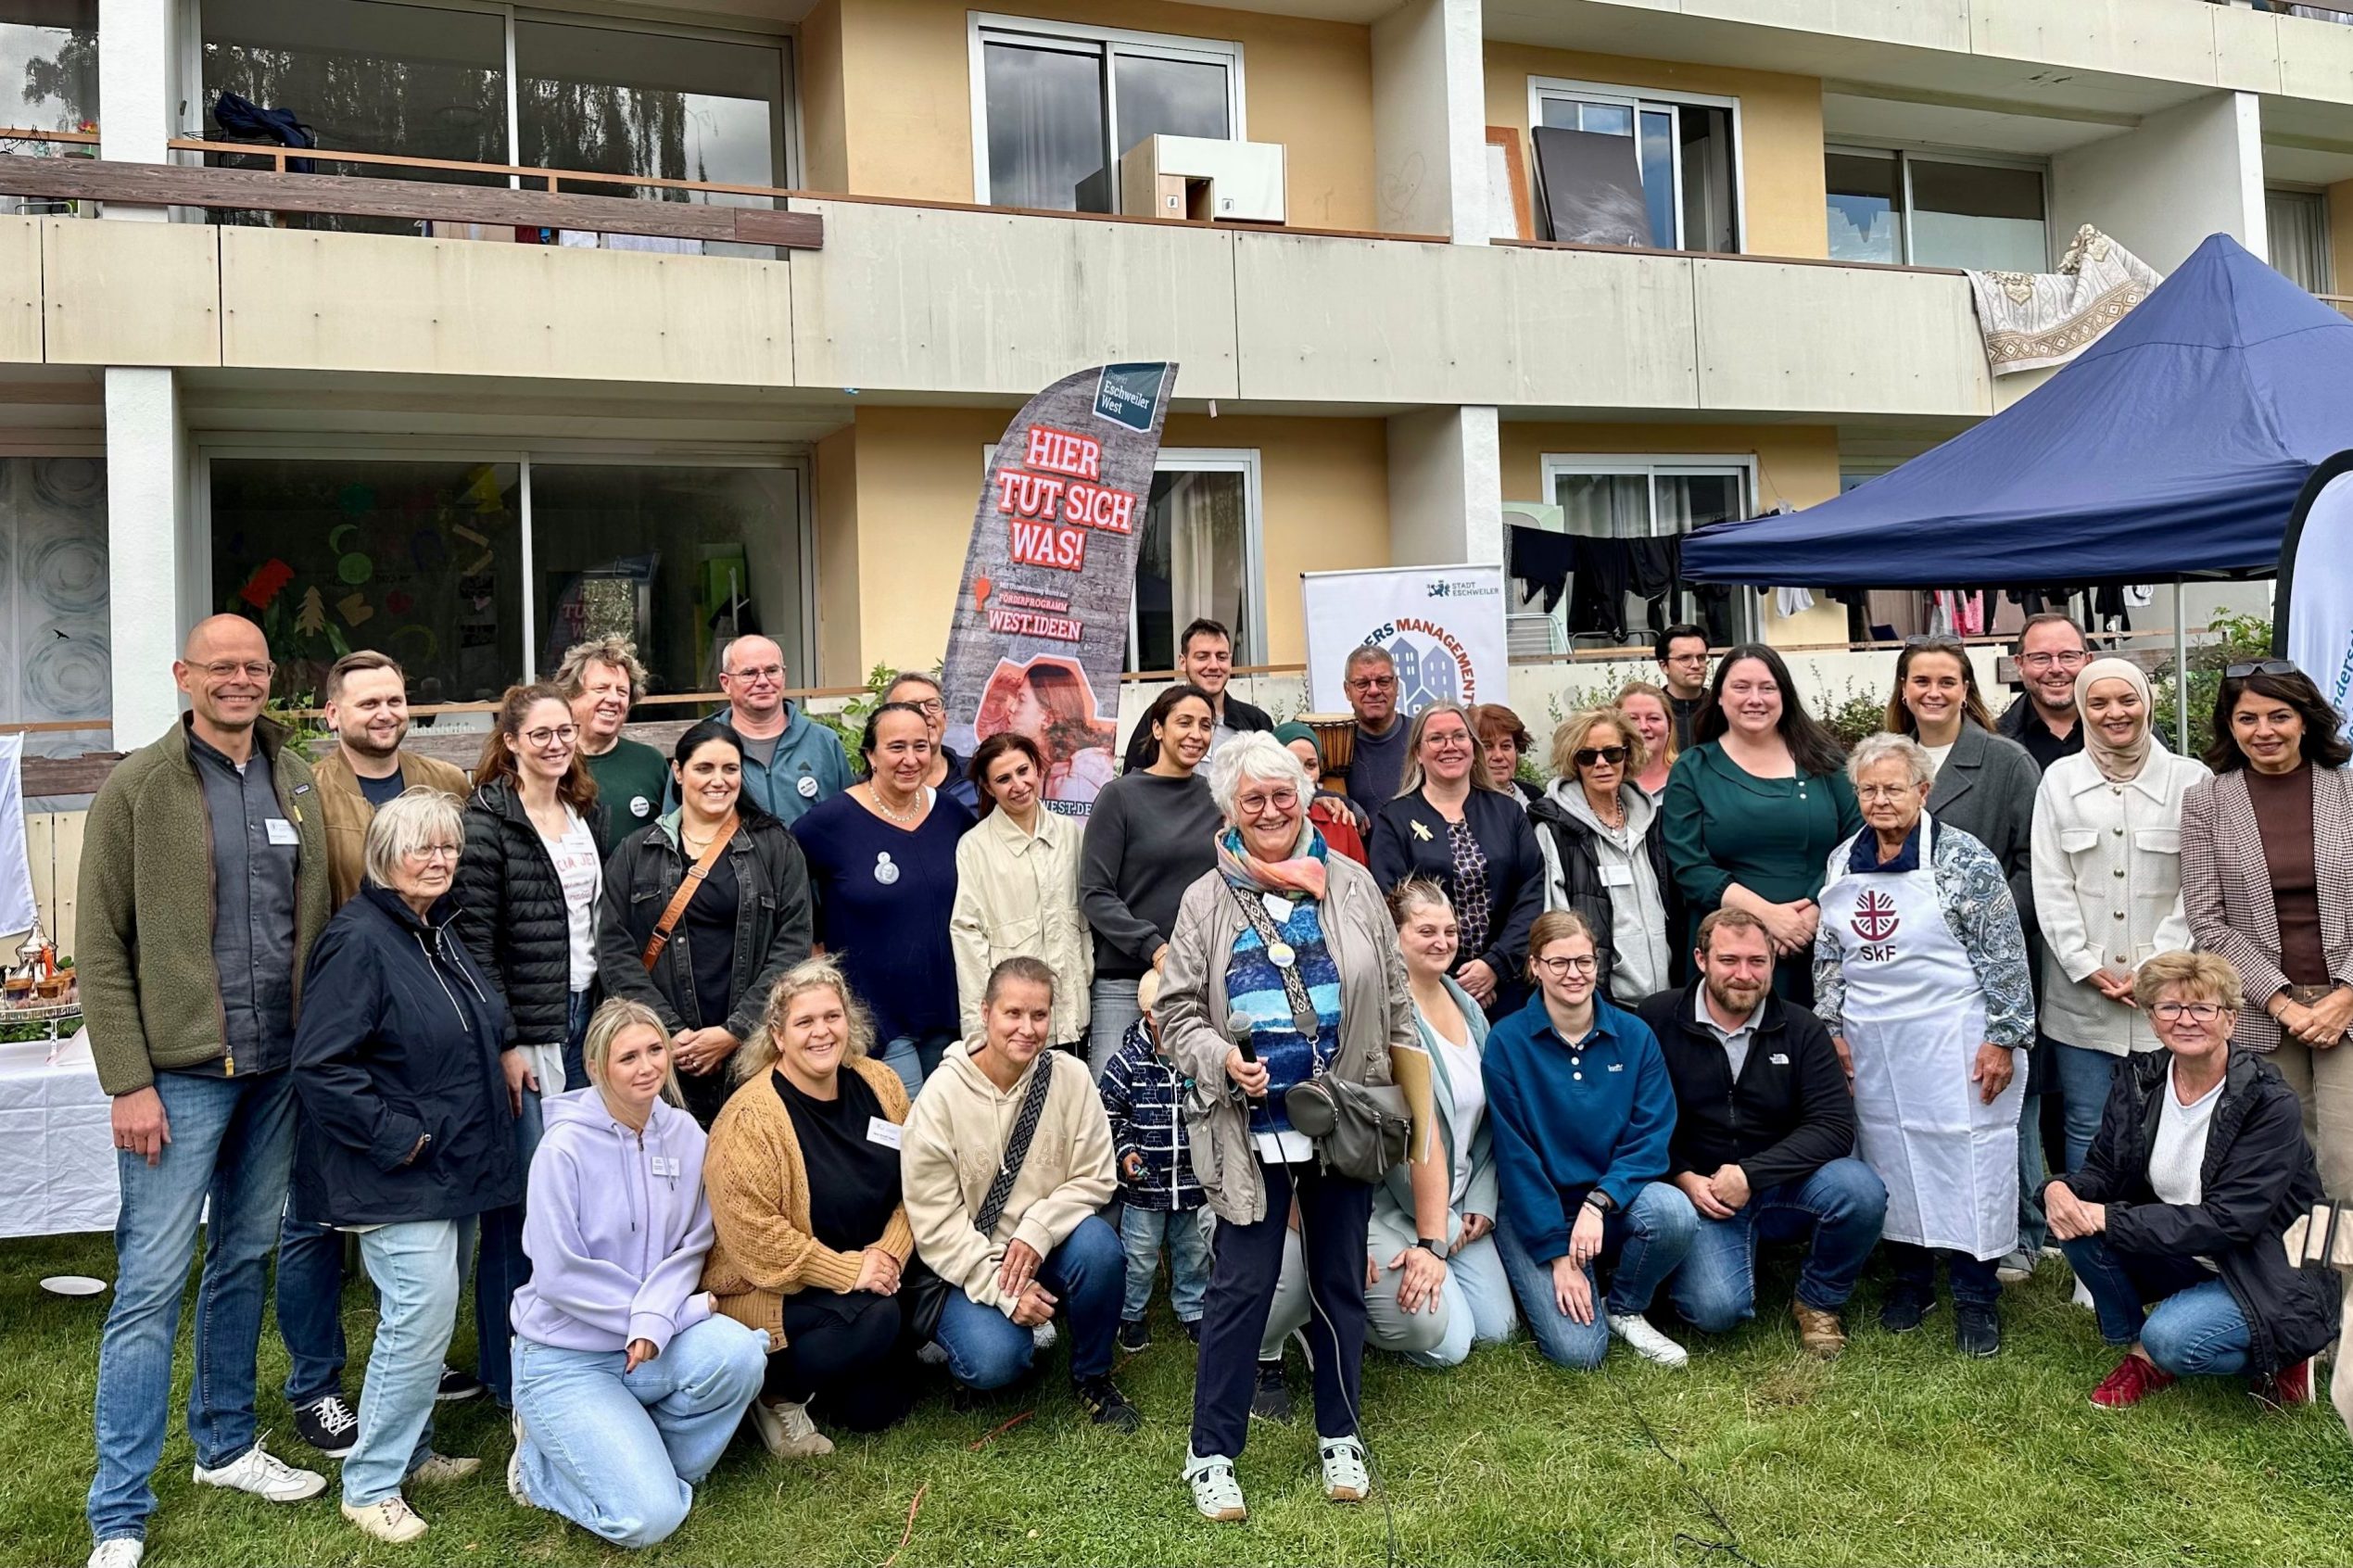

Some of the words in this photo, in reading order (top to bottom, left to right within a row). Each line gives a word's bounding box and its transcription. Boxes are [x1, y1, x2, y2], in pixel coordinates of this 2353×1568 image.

[1101, 394, 1122, 414] West
[1103, 380, 1149, 410] Eschweiler
[1026, 428, 1100, 477] HIER
[998, 471, 1063, 516] TUT
[1066, 485, 1133, 530] SICH
[1012, 522, 1084, 567] WAS!
[1451, 582, 1476, 590] STADT
[1452, 588, 1499, 597] ESCHWEILER
[988, 609, 1082, 640] WEST.IDEEN
[1860, 945, 1896, 962] SkF
